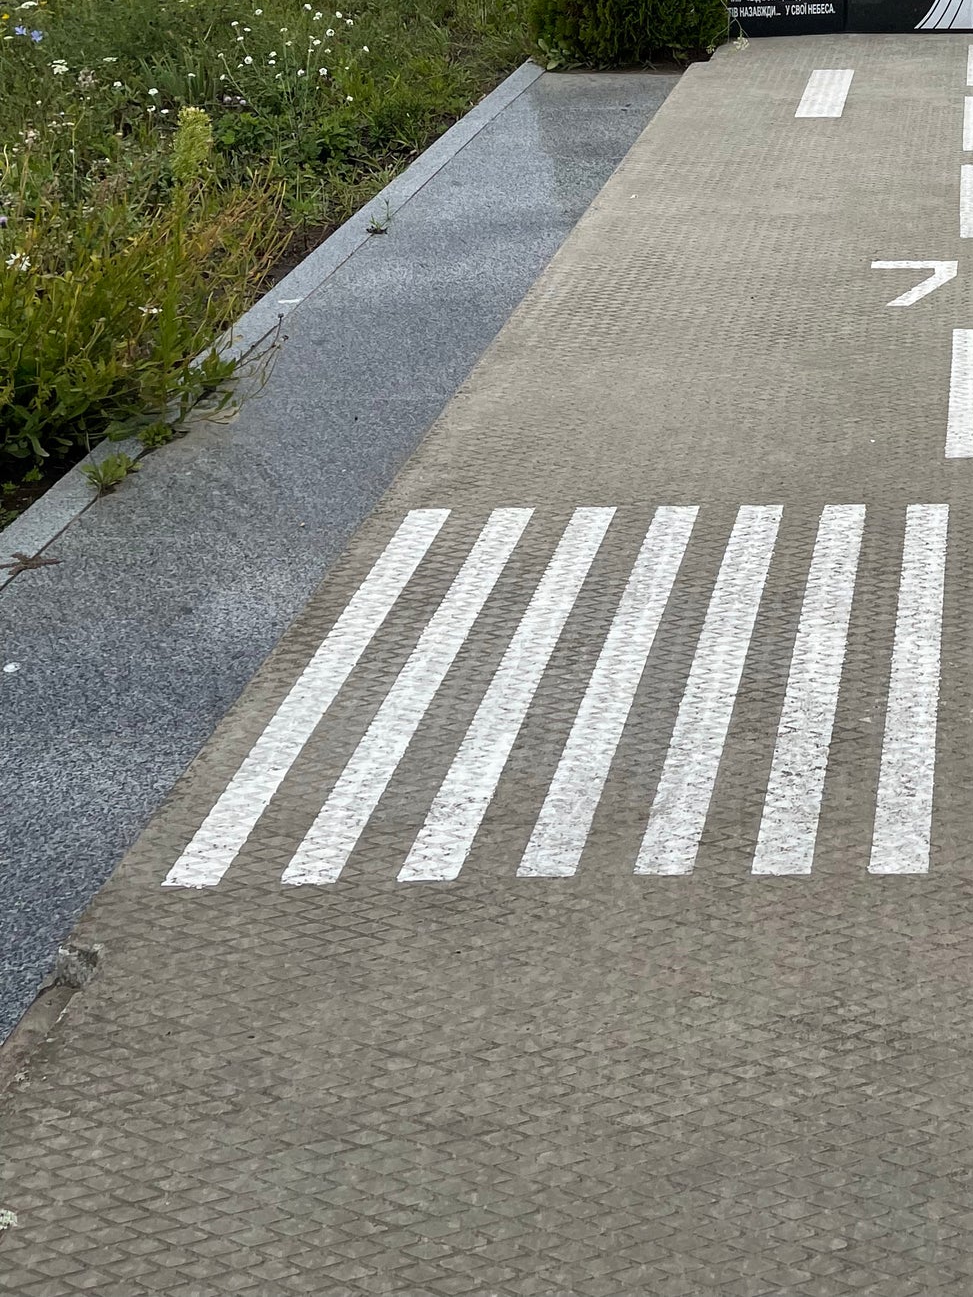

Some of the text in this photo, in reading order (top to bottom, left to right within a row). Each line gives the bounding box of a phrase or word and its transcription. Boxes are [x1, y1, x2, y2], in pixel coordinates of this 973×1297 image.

[785, 5, 790, 15] У
[791, 3, 807, 15] СВОЇ
[808, 3, 836, 14] НЕБЕСА.
